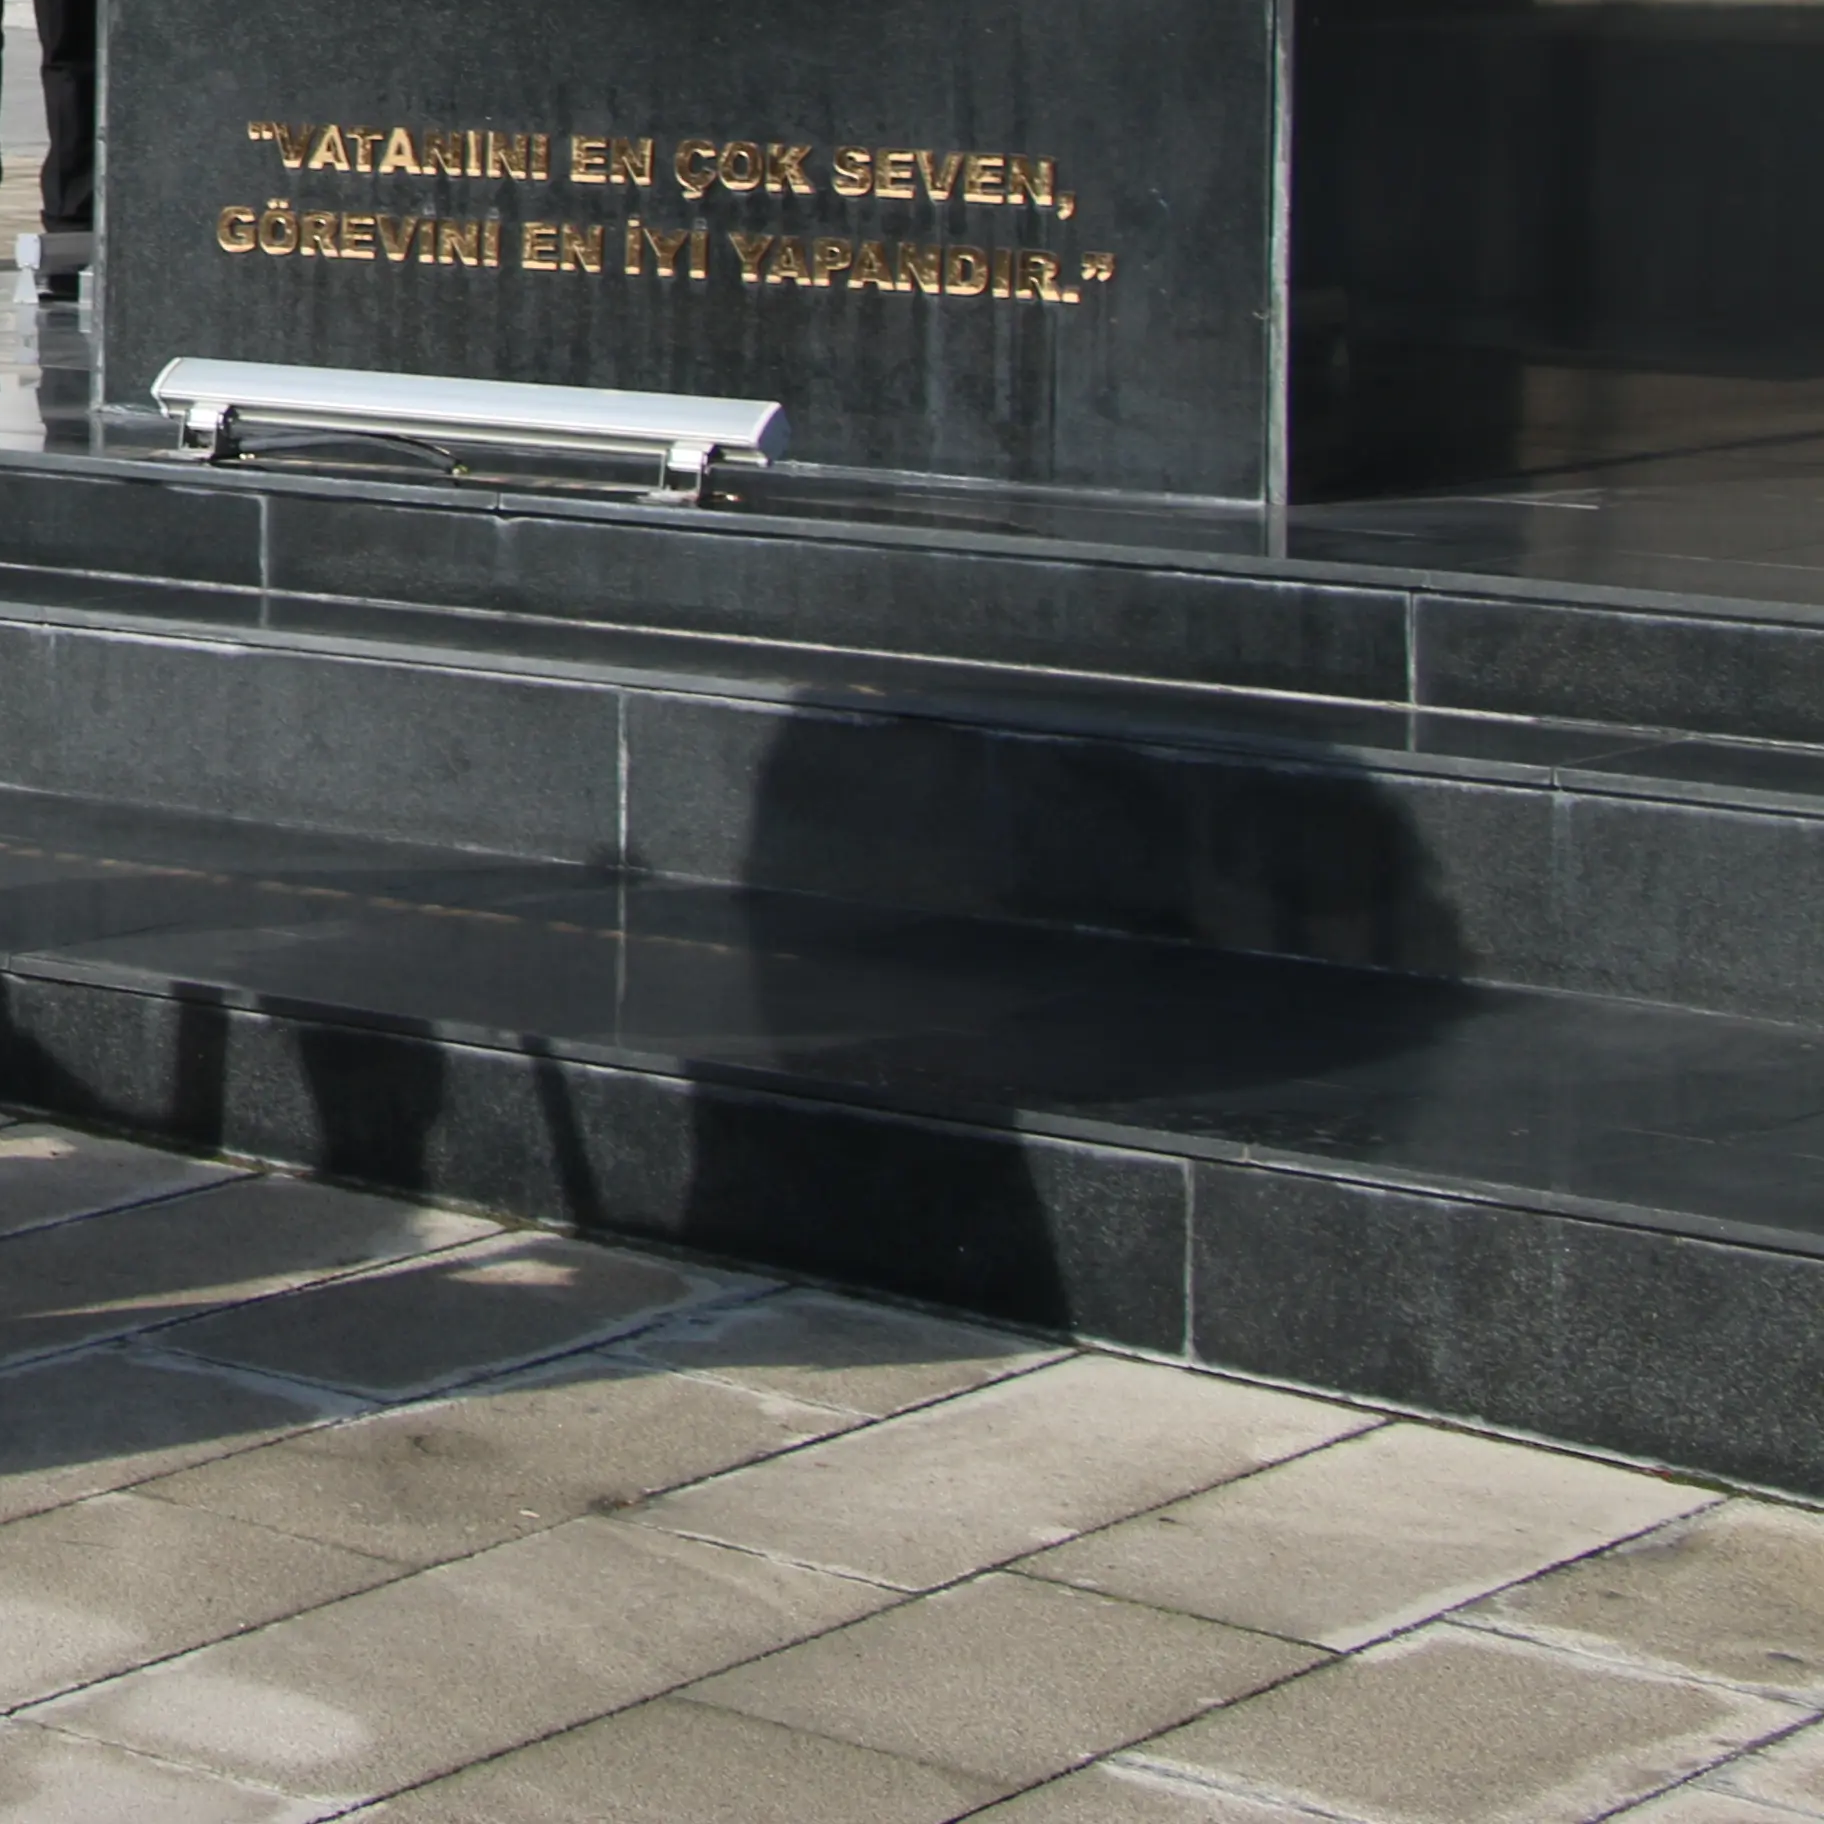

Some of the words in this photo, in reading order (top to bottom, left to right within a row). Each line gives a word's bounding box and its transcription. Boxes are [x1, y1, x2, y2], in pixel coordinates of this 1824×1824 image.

[569, 133, 655, 187] EN
[673, 138, 816, 201] ÇOK
[832, 144, 1076, 221] SEVEN,
[520, 220, 604, 274] EN
